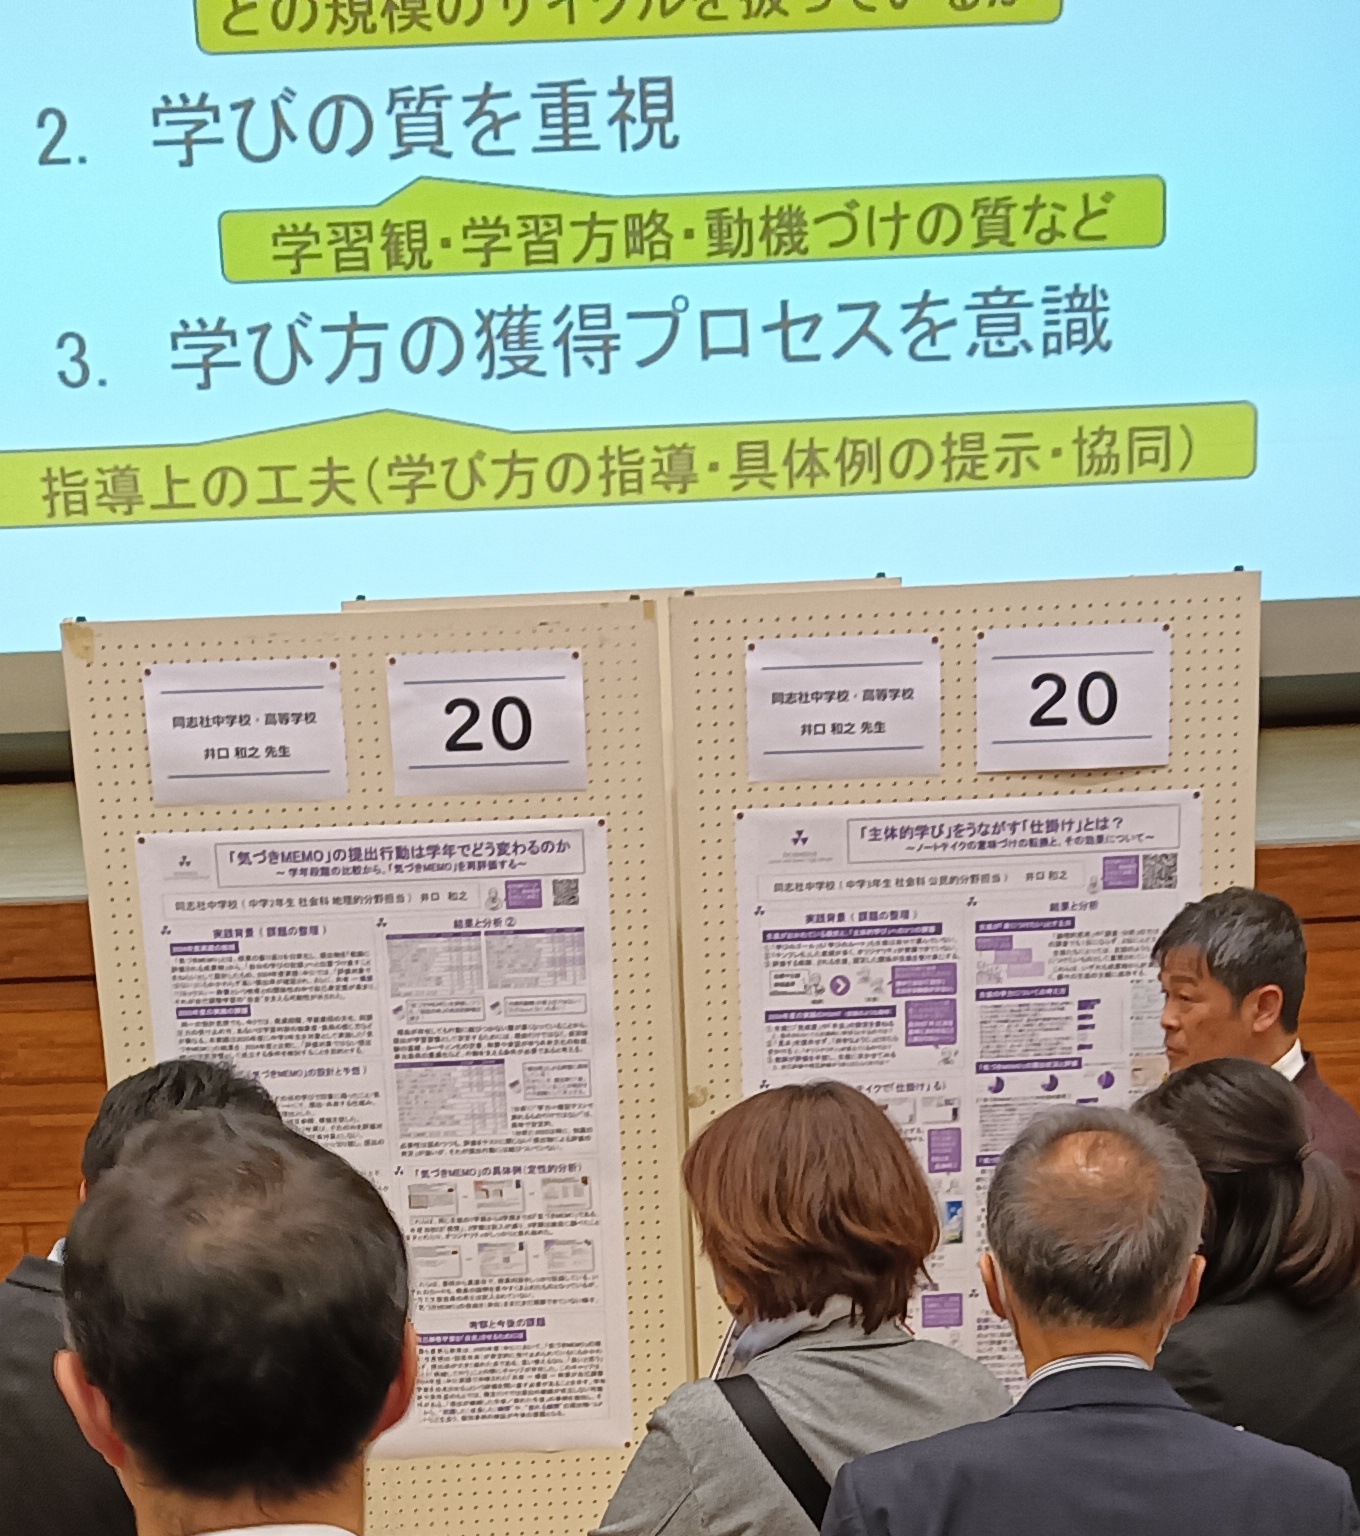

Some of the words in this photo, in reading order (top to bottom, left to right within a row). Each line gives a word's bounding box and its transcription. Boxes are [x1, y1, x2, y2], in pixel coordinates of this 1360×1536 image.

[36, 106, 87, 166] 2.
[152, 75, 680, 168] 学びの質を重視
[271, 190, 1115, 276] 学習観・学習方略・動機づけの質など
[56, 331, 107, 389] 3.
[170, 282, 1113, 391] 学び方の獲得プロセスを意識
[444, 696, 532, 752] 20
[1029, 671, 1118, 727] 20
[204, 747, 229, 760] 井口
[265, 745, 291, 758] 先生
[801, 723, 826, 736] 井口
[860, 721, 886, 734] 先生
